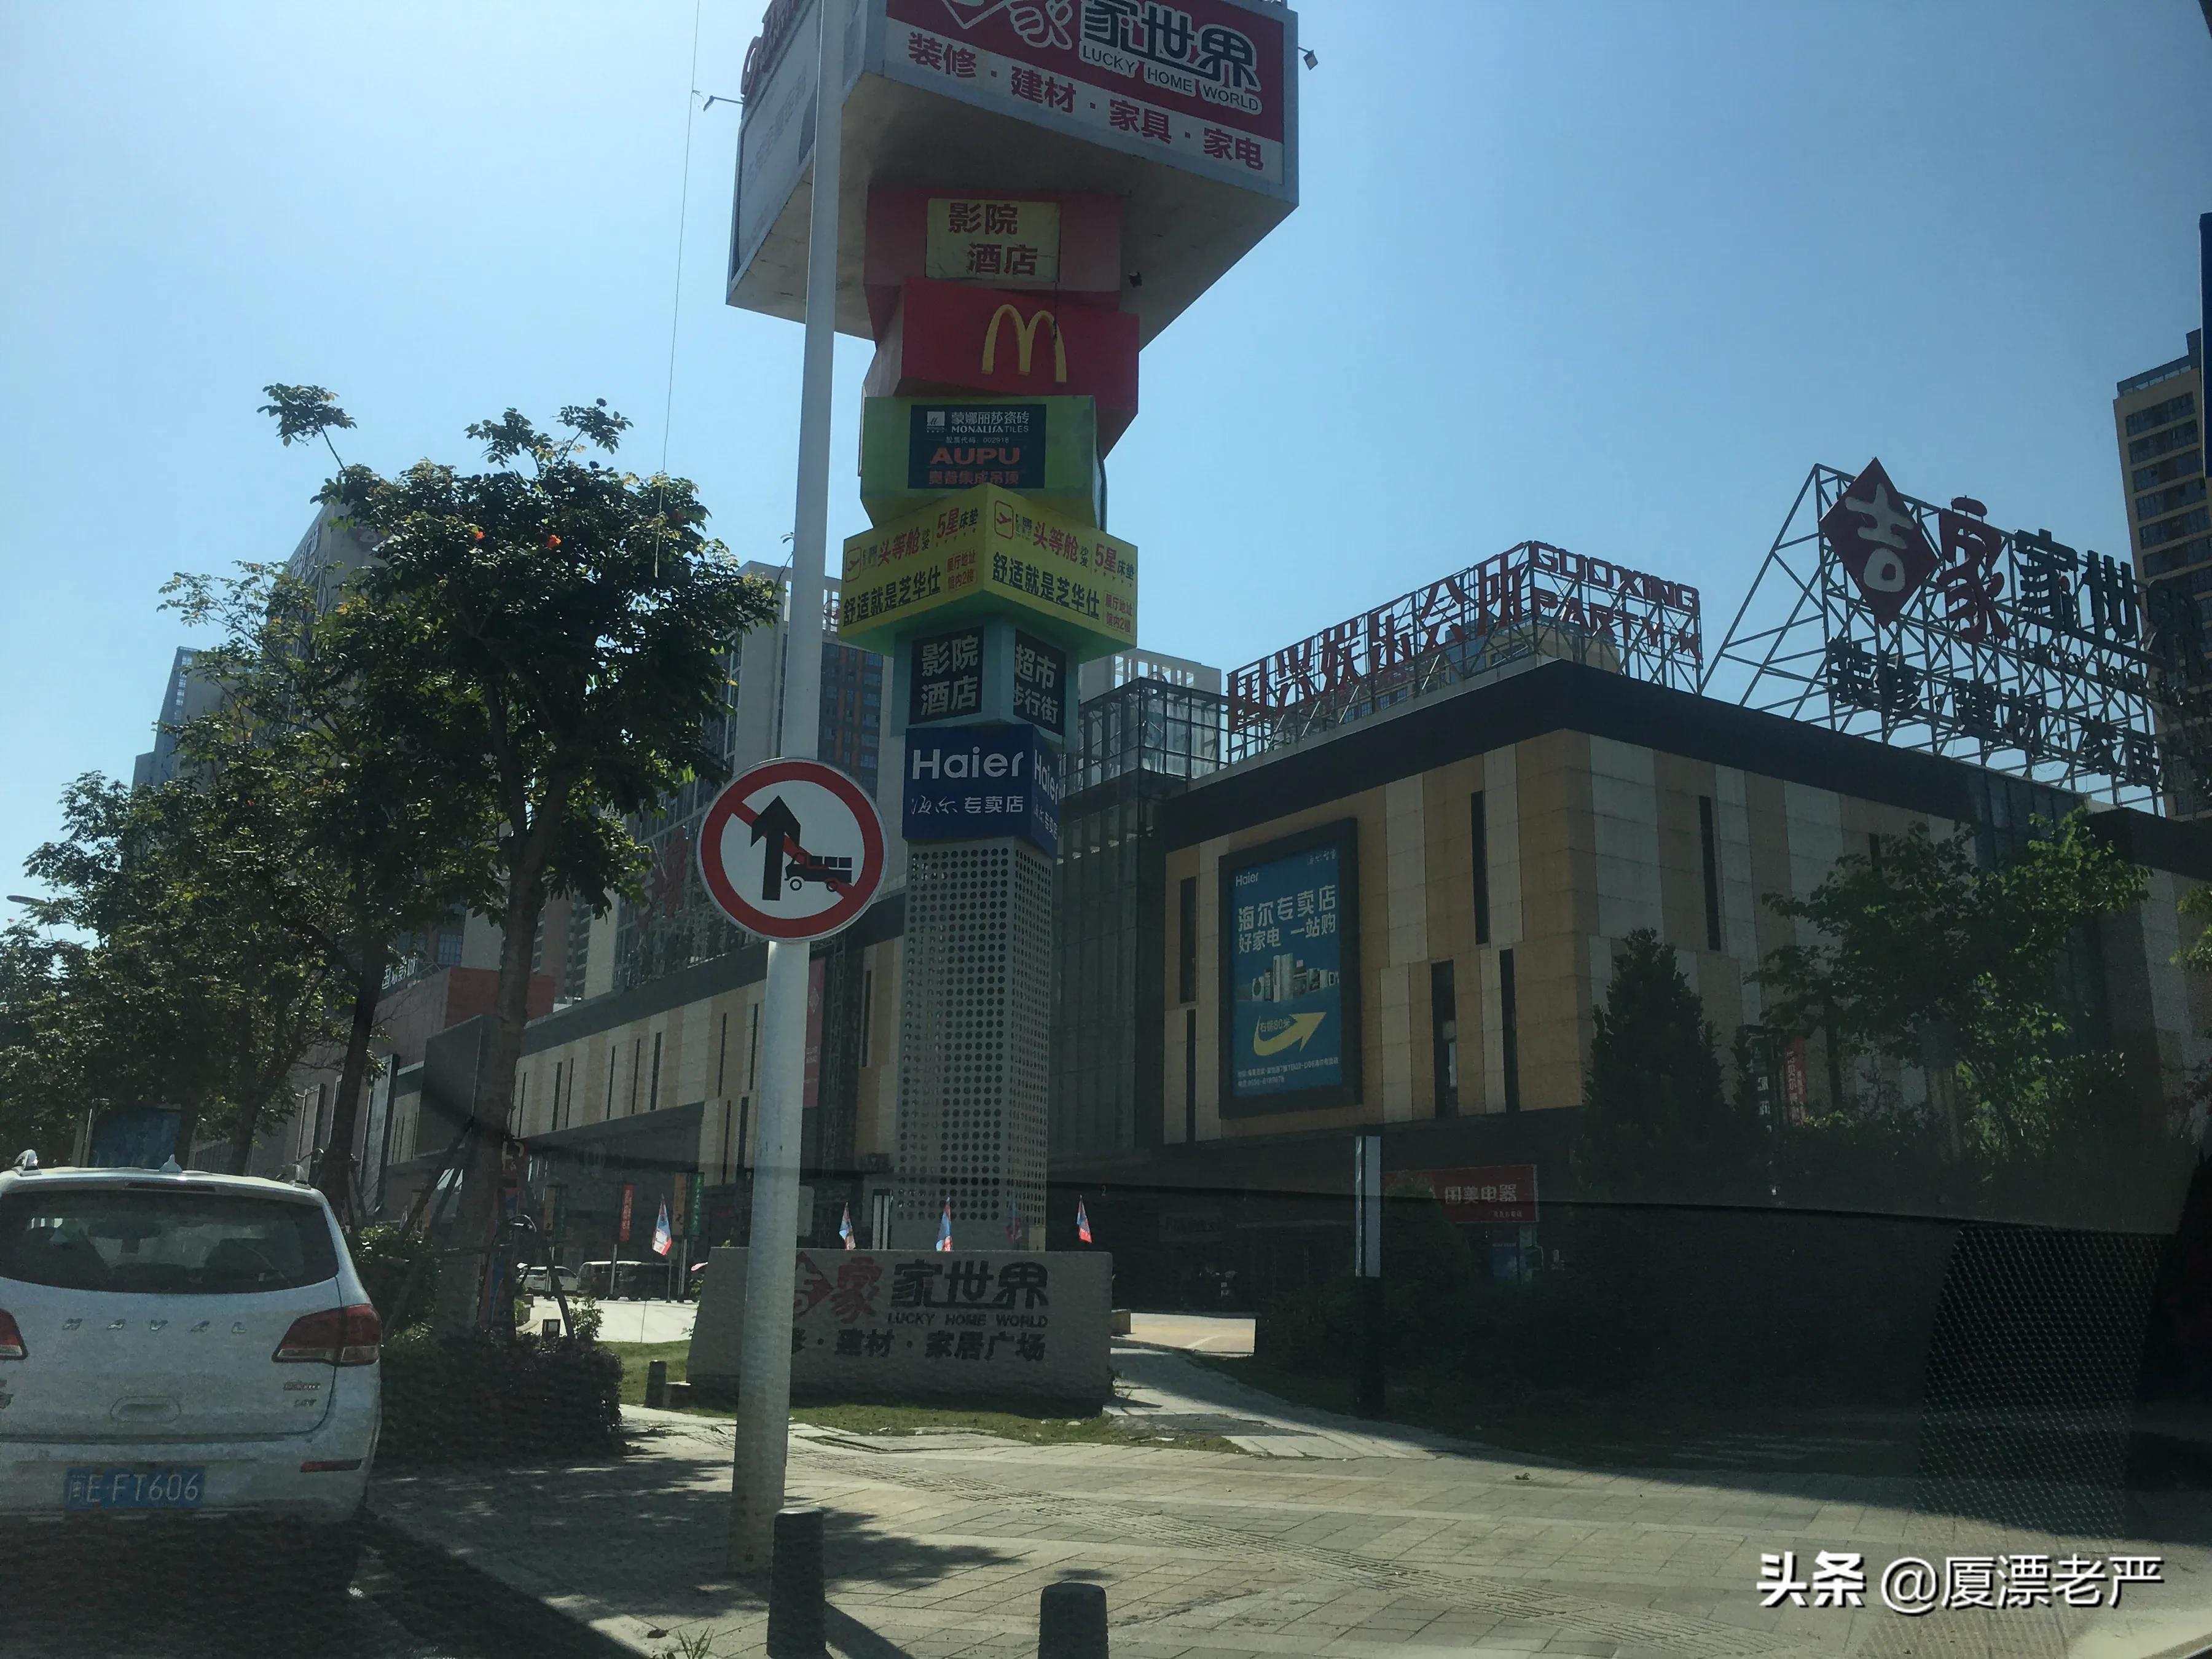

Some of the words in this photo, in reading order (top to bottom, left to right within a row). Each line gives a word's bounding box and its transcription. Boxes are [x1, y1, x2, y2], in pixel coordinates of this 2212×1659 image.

[1082, 45, 1135, 74] LUCKY
[1147, 69, 1193, 93] HOME
[1203, 85, 1260, 112] WORLD
[949, 203, 1018, 235] 影院
[967, 242, 1038, 275] 酒店
[951, 411, 1030, 425] 蒙娜丽莎瓷砖
[930, 447, 1020, 465] AUPU
[878, 527, 920, 567] 头等舱
[1033, 522, 1078, 562] 头等舱
[843, 565, 941, 627] 舒适就是芝华仕
[992, 552, 1099, 619] 舒适就是芝华仕
[1532, 541, 1700, 614] GUOXING
[1531, 587, 1664, 647] PARTY
[921, 634, 979, 677] 影院
[1014, 644, 1057, 689] 超市
[920, 675, 978, 716] 酒店
[1013, 682, 1058, 725] 步行街
[912, 746, 1025, 780] Haier
[1034, 749, 1058, 805] Haier
[1236, 871, 1259, 887] Haier
[1238, 885, 1336, 932] 海尔专卖店
[1239, 927, 1282, 954] 好家电
[1290, 912, 1336, 938] 一站购
[1445, 1183, 1517, 1204] 国美电器
[887, 1312, 935, 1325] LUCKY
[945, 1314, 987, 1326] HOME
[995, 1314, 1048, 1327] WORLD
